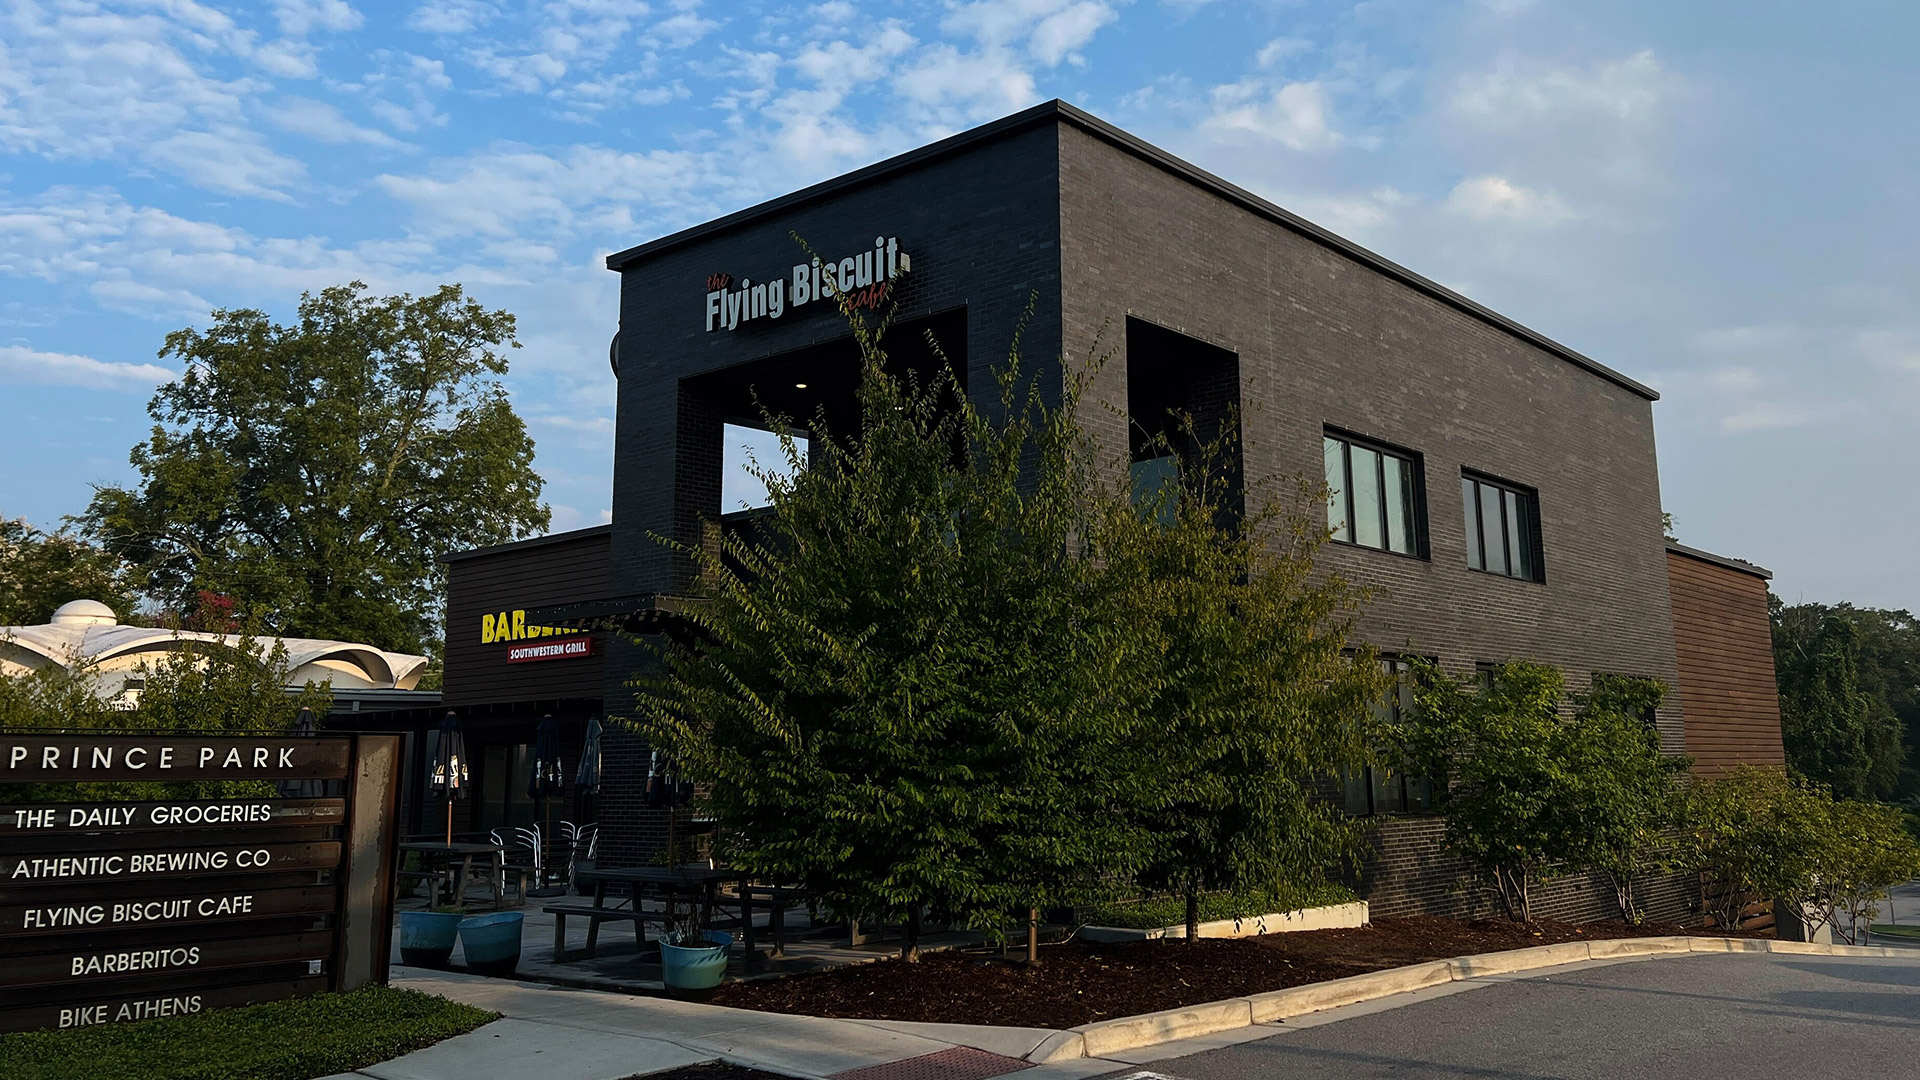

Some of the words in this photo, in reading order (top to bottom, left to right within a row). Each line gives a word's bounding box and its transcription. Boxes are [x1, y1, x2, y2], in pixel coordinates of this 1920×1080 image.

[705, 278, 784, 332] Flying
[792, 236, 898, 307] Biscuit
[706, 272, 731, 292] the
[510, 645, 564, 660] SOUTHWESTERN
[565, 641, 587, 654] GRILL
[10, 746, 174, 770] PRINCE
[199, 747, 295, 768] PARK
[15, 809, 56, 829] THE
[69, 807, 137, 827] DAILY
[150, 804, 271, 825] GROCERIES
[11, 856, 124, 879] ATHENTIC
[129, 851, 229, 873] BREWING
[235, 849, 271, 868] CO
[23, 905, 105, 929] FLYING
[112, 899, 192, 923] BISCUIT
[198, 895, 253, 916] CAFE
[71, 946, 200, 976] BARBERITOS
[58, 1005, 108, 1028] BIKE
[114, 995, 202, 1022] ATHENS
